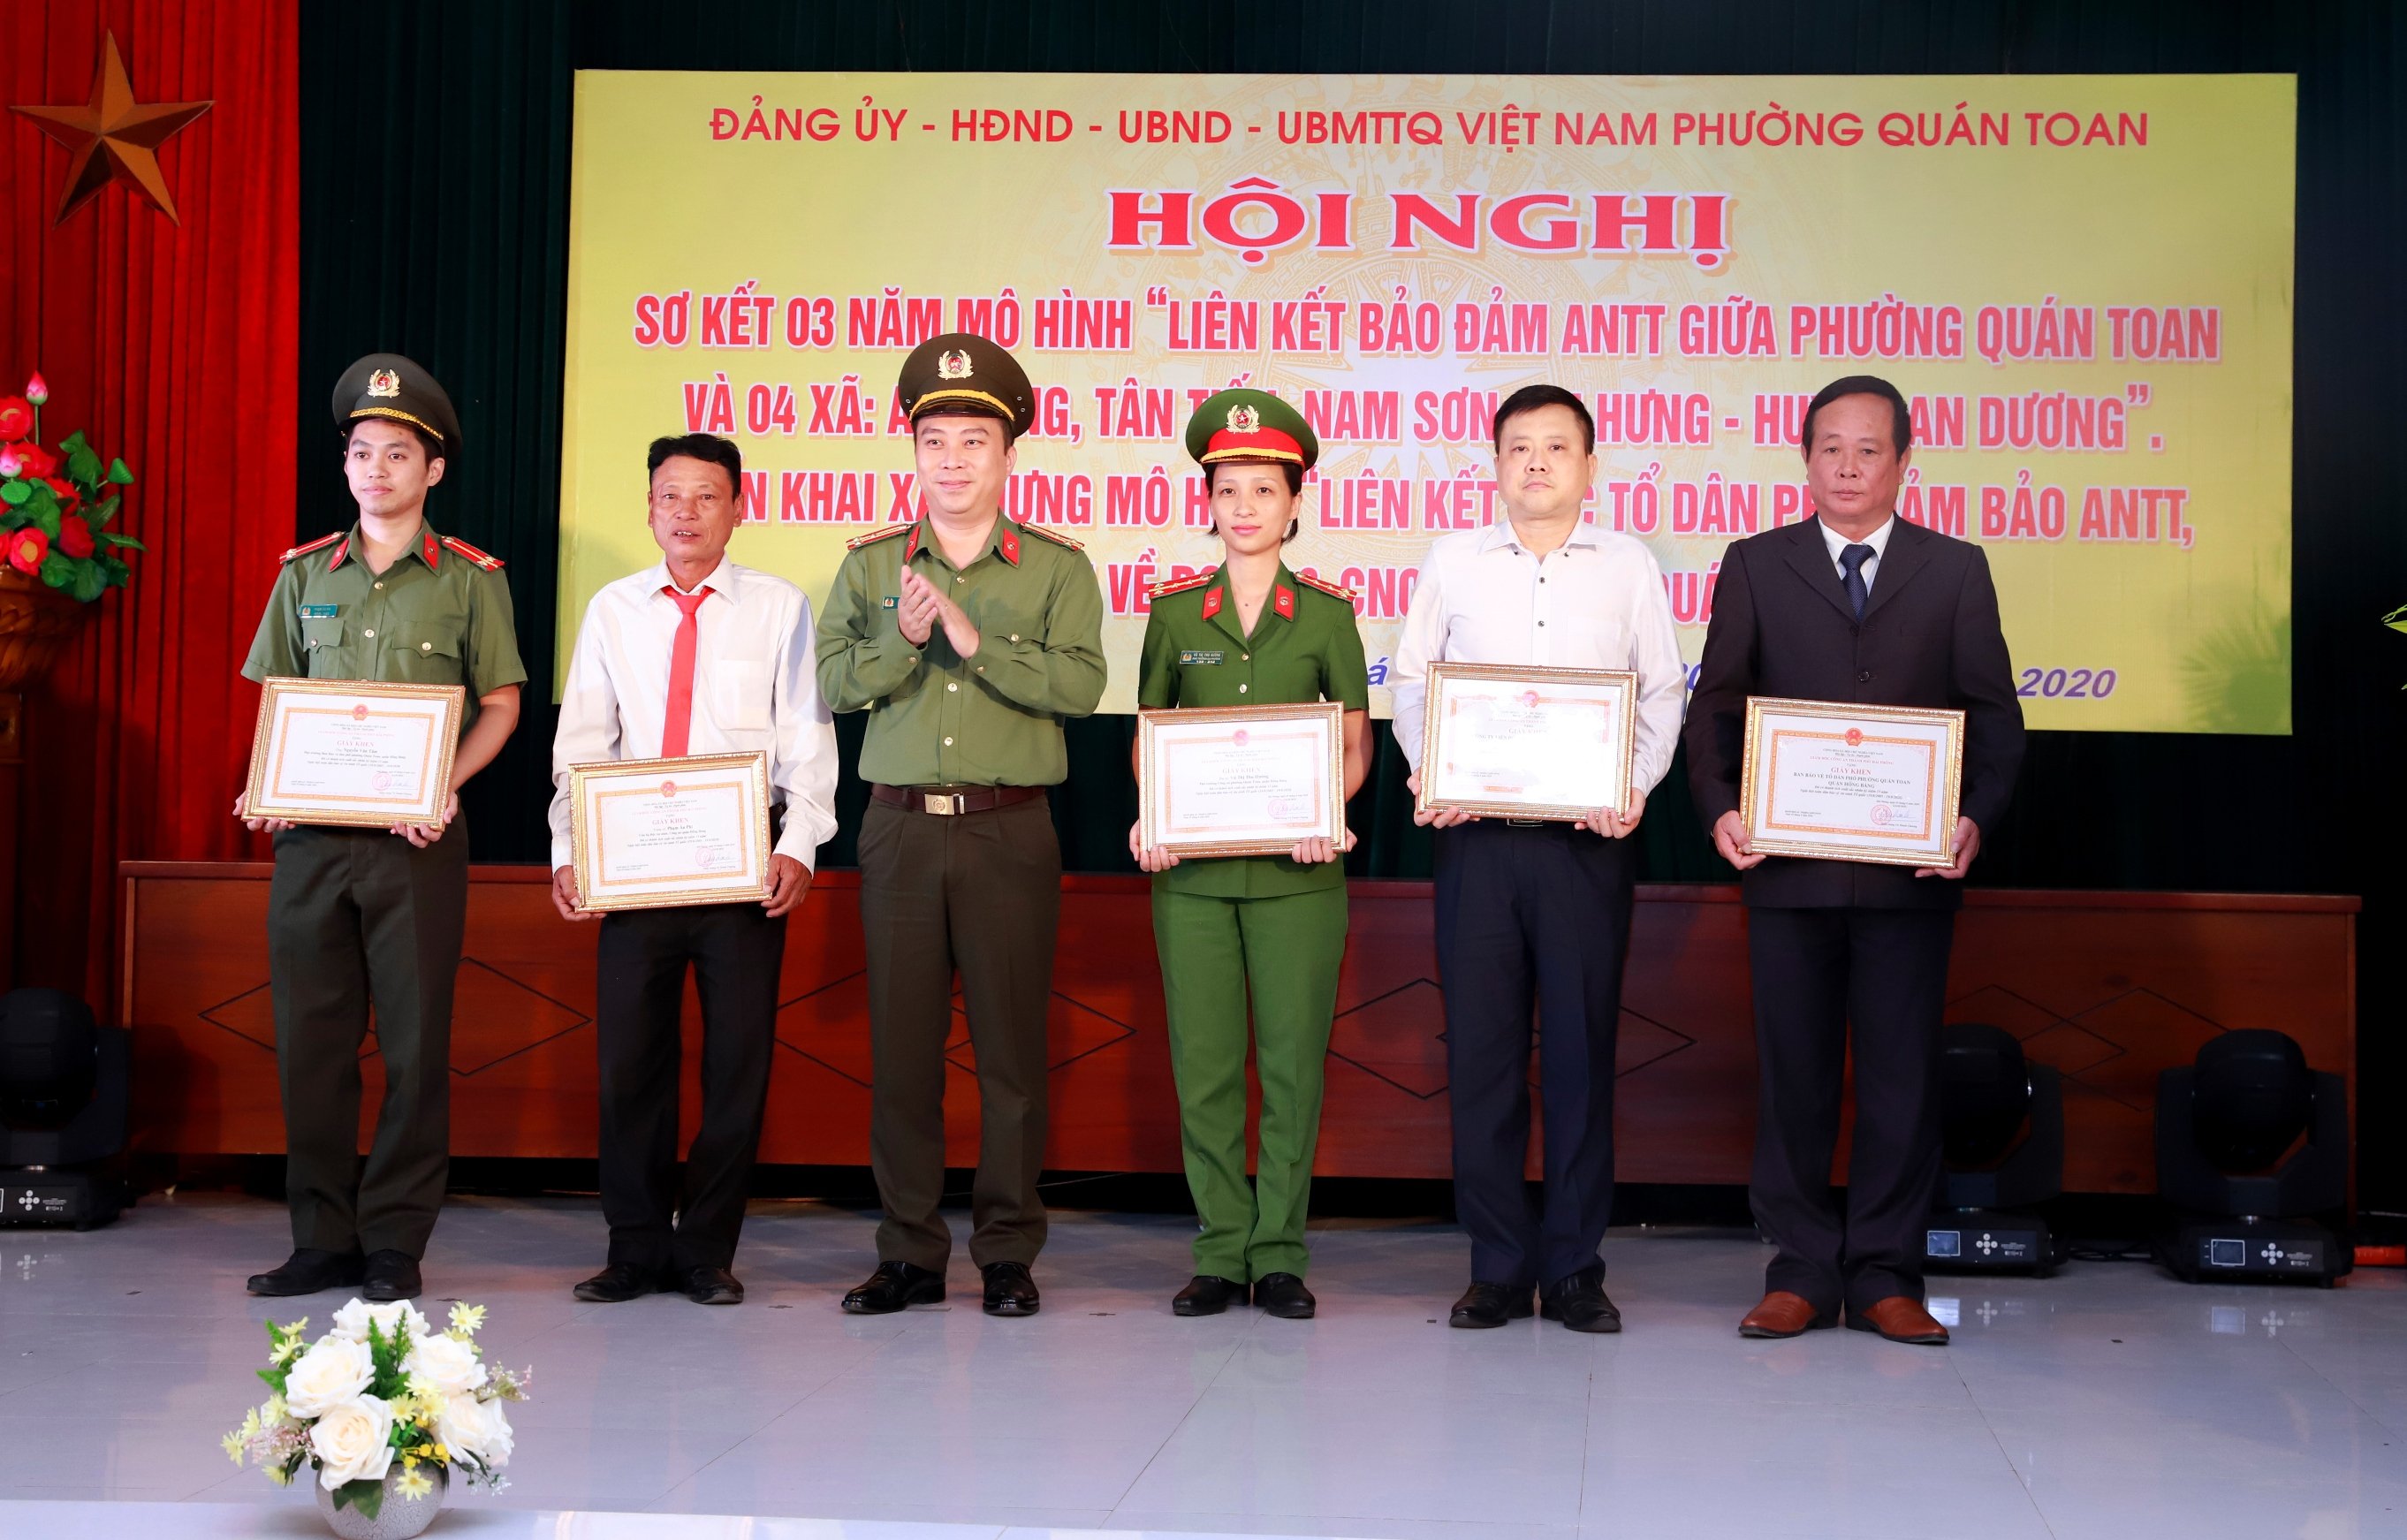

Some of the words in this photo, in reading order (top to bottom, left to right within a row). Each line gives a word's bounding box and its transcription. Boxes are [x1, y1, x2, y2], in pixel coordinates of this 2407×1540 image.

[709, 95, 841, 142] ĐẢNG
[854, 95, 908, 142] ỦY
[952, 109, 1074, 142] HĐND
[1119, 110, 1233, 144] UBND
[1278, 110, 1443, 146] UBMTTQ
[1456, 103, 1542, 154] VIỆT
[1554, 112, 1658, 146] NAM
[1674, 101, 1864, 147] PHƯỜNG
[1878, 102, 2009, 148] QUÁN
[2024, 112, 2148, 148] TOAN
[1108, 177, 1351, 263] HỘI
[1390, 193, 1726, 266] NGHỊ
[635, 291, 690, 345] SƠ
[701, 280, 775, 345] KẾT
[786, 297, 835, 347] 03
[848, 284, 944, 347] NĂM
[958, 287, 1020, 347] MÔ
[1034, 288, 1132, 349] HÌNH
[1272, 285, 1347, 352] KẾT
[1359, 284, 1440, 353] BẢO
[1454, 285, 1548, 353] ĐẢM
[1562, 304, 1667, 354] ANTT
[1679, 295, 1776, 355] GIỮA
[1791, 293, 1962, 357] PHƯỜNG
[1978, 296, 2092, 361] QUÁN
[2107, 307, 2218, 359] TOAN
[684, 373, 734, 433] VÀ
[748, 384, 796, 434] 04
[809, 375, 875, 434] XÃ:
[1095, 376, 1173, 437] TÂN
[1304, 390, 1399, 440] NAM
[1597, 388, 1710, 444] HƯNG
[1725, 417, 1740, 429] -
[1910, 396, 1964, 446] AN
[781, 472, 865, 522] KHAI
[1105, 466, 1170, 527] MÔ
[1424, 464, 1500, 529] KẾT
[1608, 462, 1660, 533] TỔ
[1673, 472, 1758, 534] DÂN
[1894, 468, 1966, 536] ẢM
[1981, 469, 2065, 538] BẢO
[2080, 489, 2193, 546] ANTT,
[1107, 548, 1156, 613] VỀ
[2016, 668, 2117, 698] 2020
